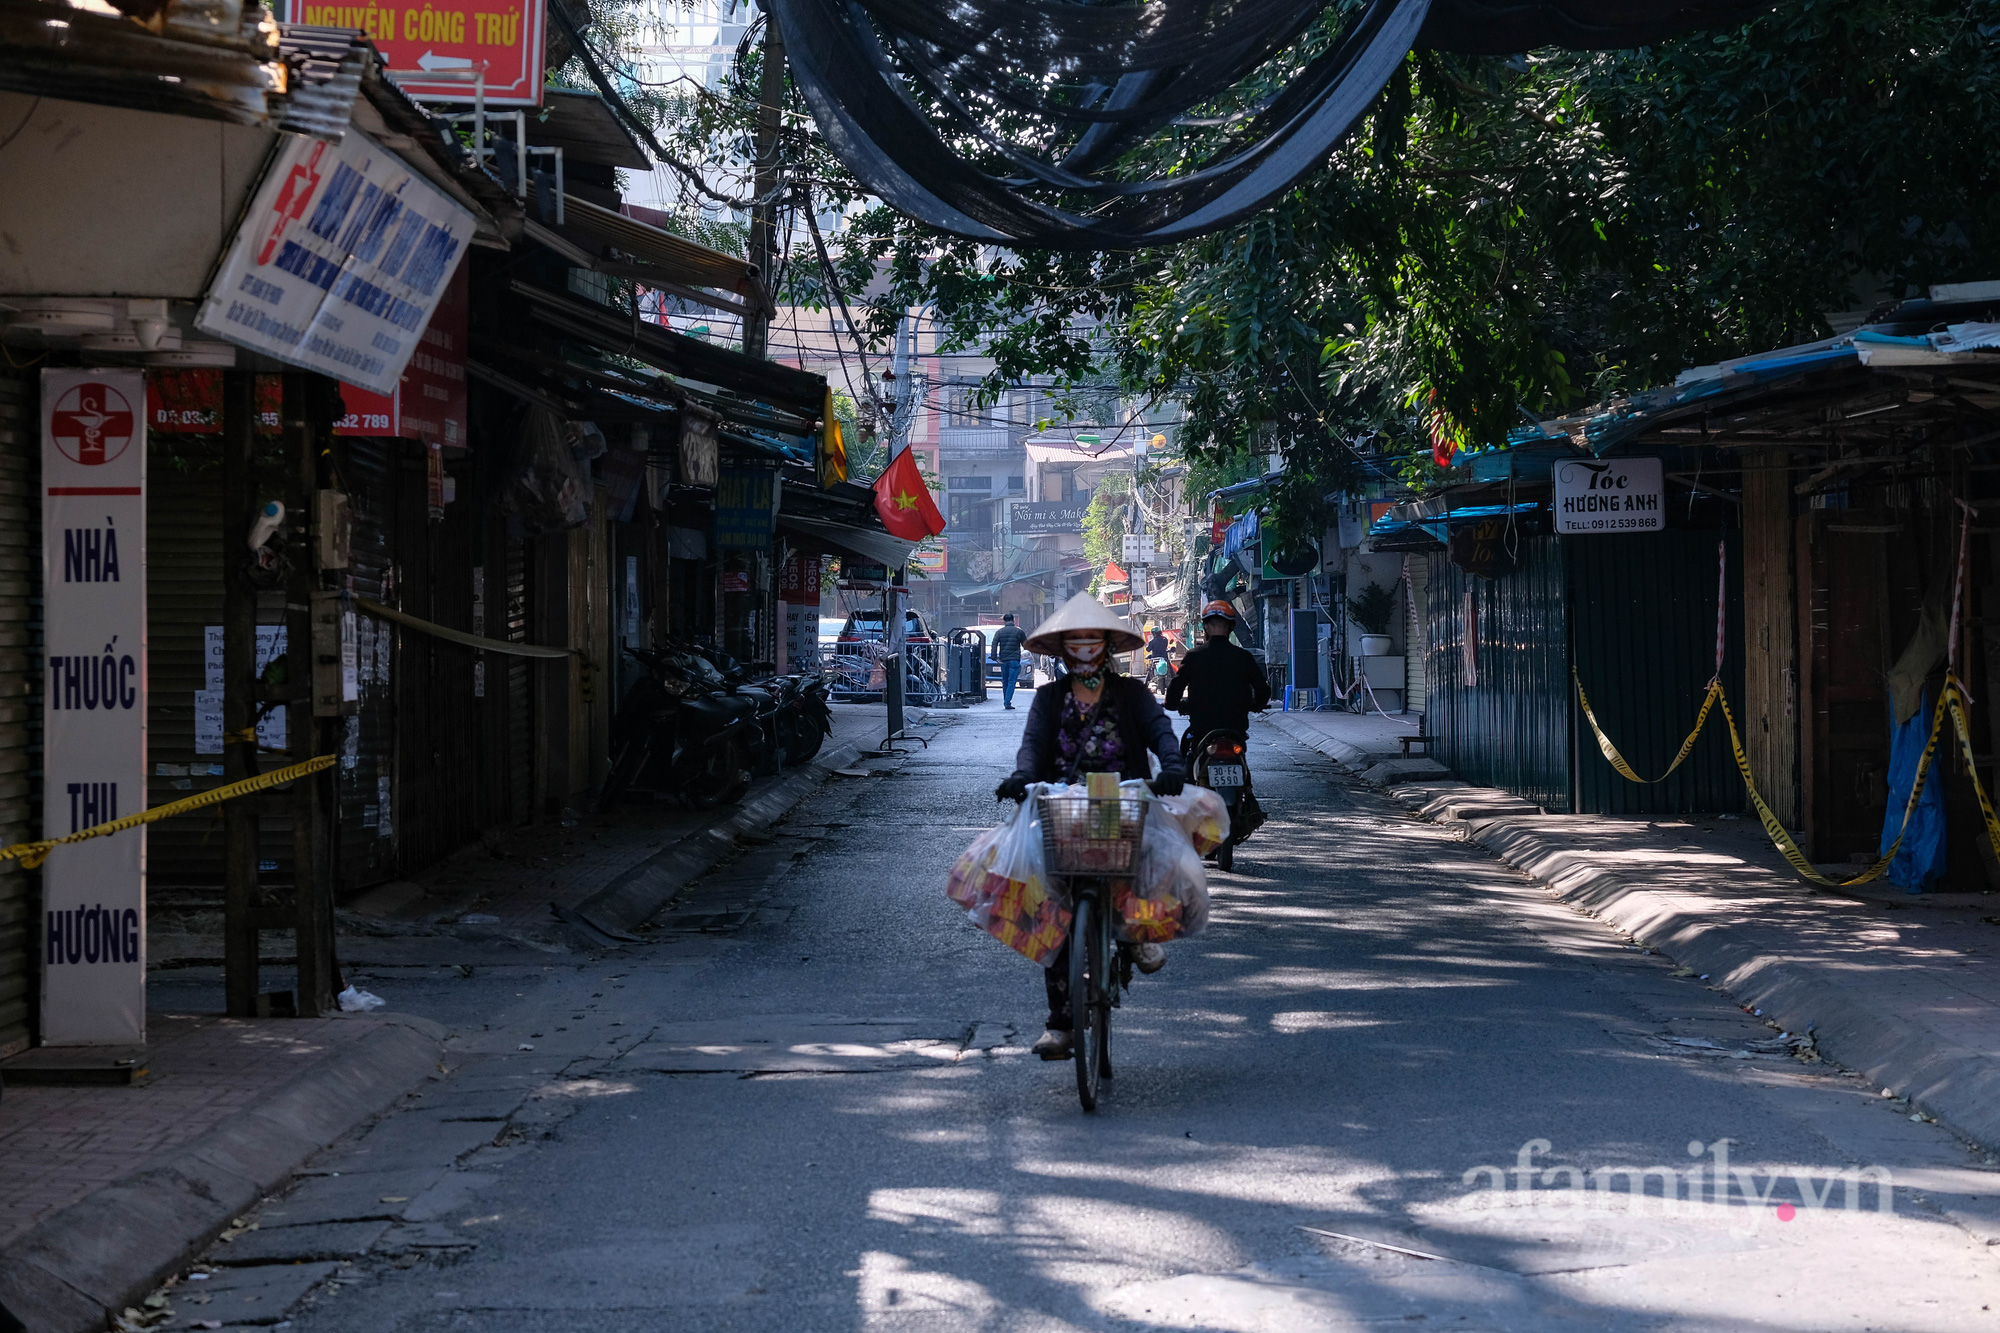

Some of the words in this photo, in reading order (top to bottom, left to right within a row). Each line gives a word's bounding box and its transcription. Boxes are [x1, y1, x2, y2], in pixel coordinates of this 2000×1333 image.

[404, 2, 465, 45] CÔNG
[474, 6, 520, 47] TRỨ
[362, 413, 390, 429] 789
[1561, 461, 1629, 491] Tóc
[1034, 510, 1047, 520] mi
[1049, 510, 1057, 520] &
[1563, 493, 1620, 513] HƯƠNG
[1624, 494, 1658, 511] ANH
[65, 516, 119, 582] NHÀ
[50, 635, 135, 710] THUỐC
[1214, 775, 1239, 785] 5590
[67, 782, 117, 836] THU
[47, 903, 138, 965] HƯƠNG
